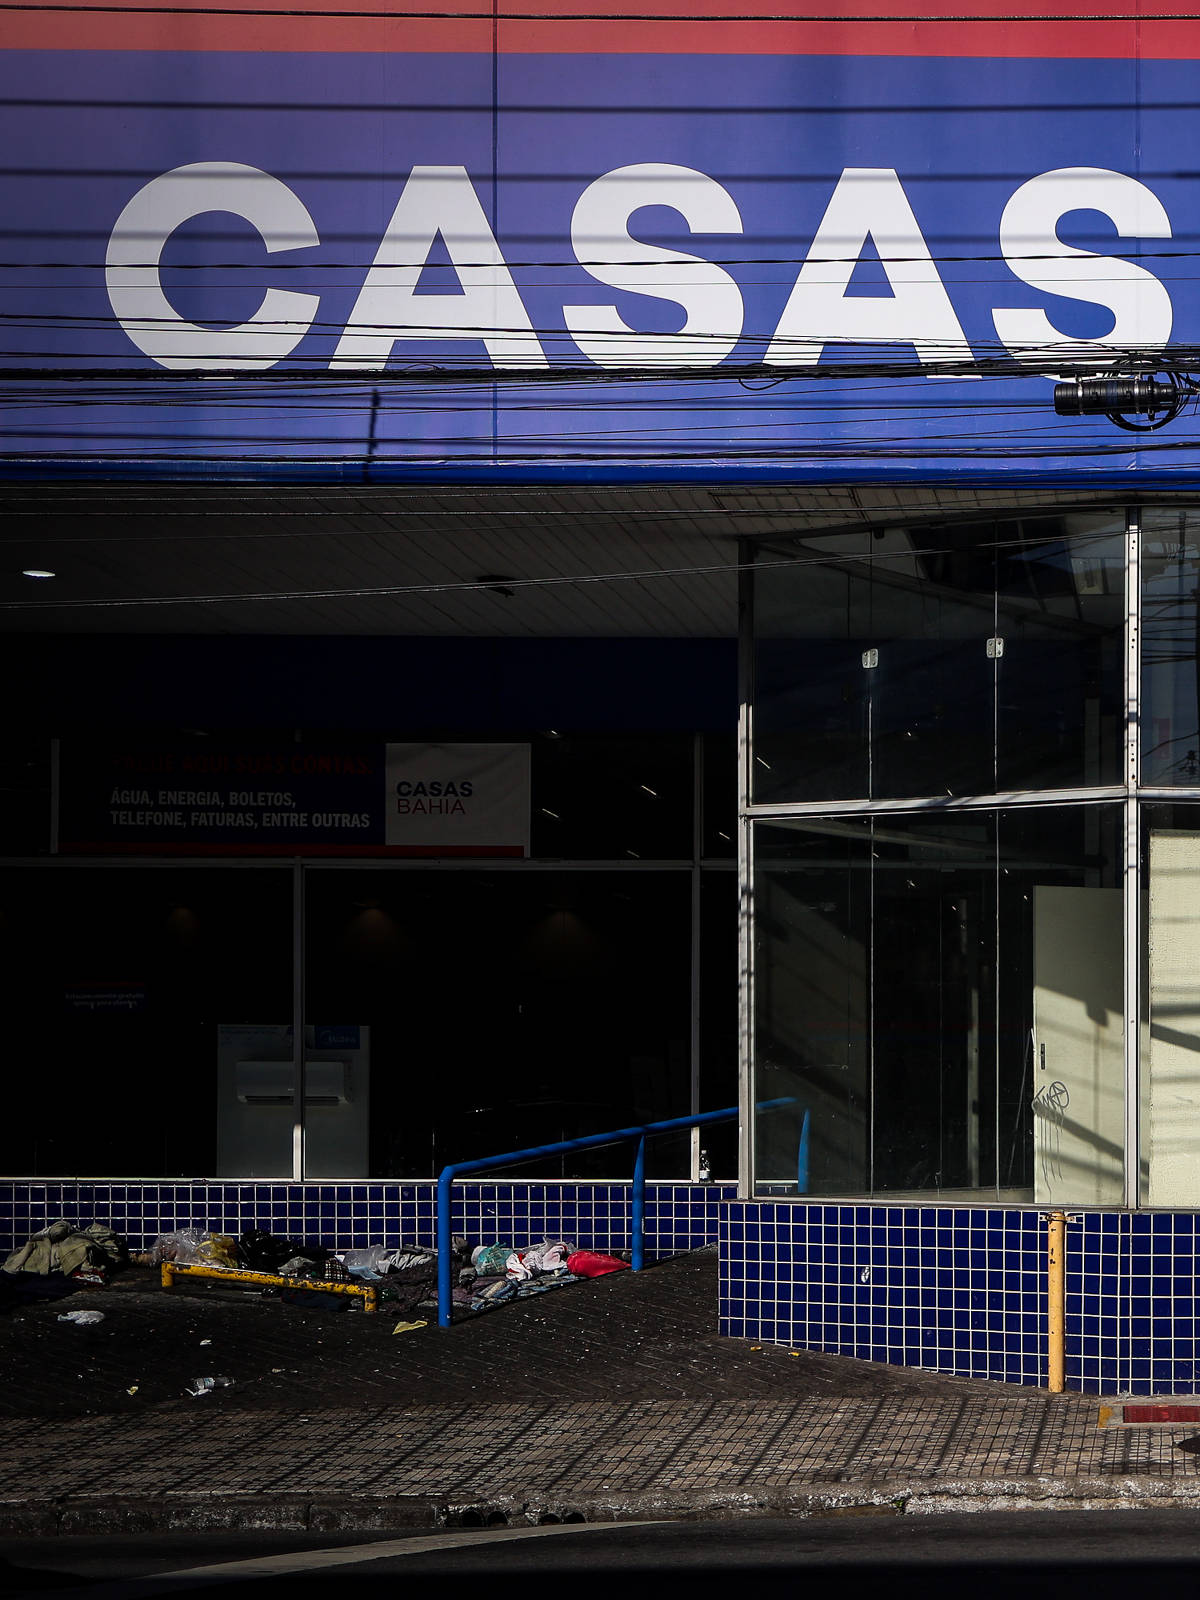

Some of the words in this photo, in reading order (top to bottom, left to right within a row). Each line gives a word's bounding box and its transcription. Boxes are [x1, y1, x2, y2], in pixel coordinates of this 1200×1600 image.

[109, 786, 154, 807] ÁGUA,
[158, 790, 225, 808] ENERGIA,
[229, 791, 297, 809] BOLETOS,
[396, 781, 473, 798] CASAS
[397, 798, 466, 815] BAHIA
[109, 810, 187, 828] TELEFONE,
[191, 811, 258, 829] FATURAS,
[262, 813, 308, 828] ENTRE
[311, 813, 371, 828] OUTRAS
